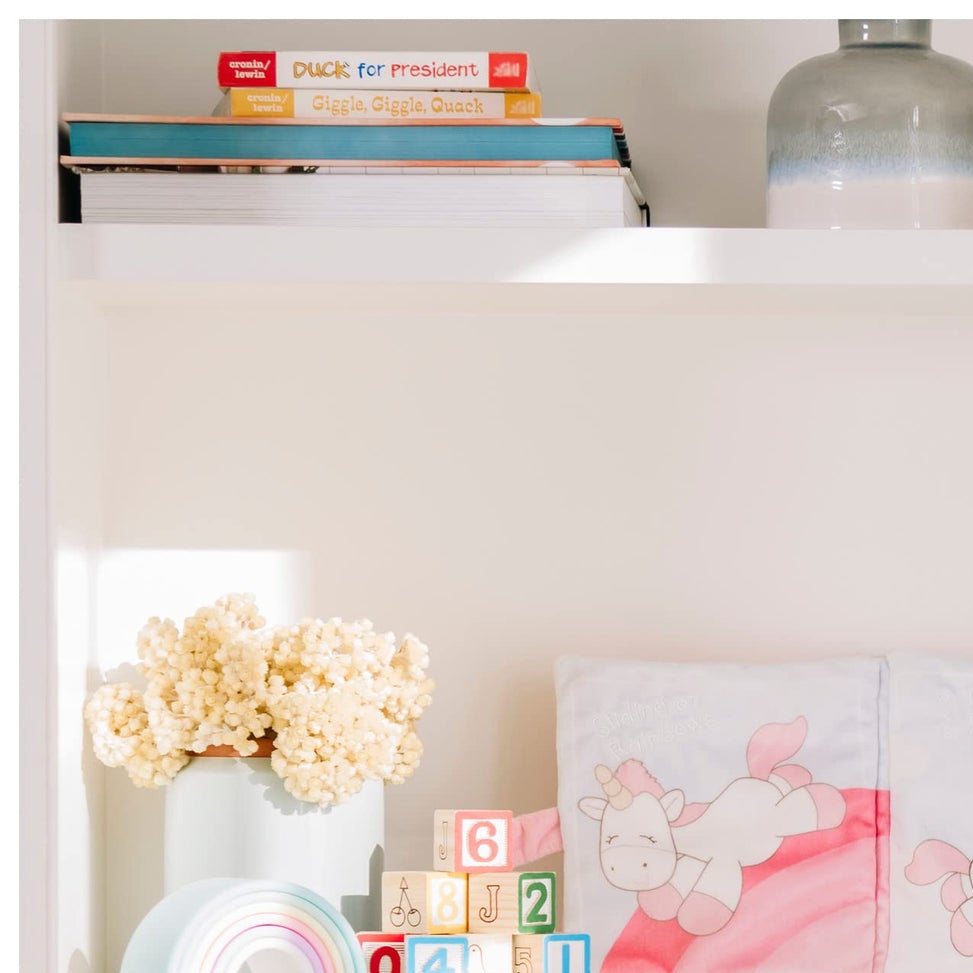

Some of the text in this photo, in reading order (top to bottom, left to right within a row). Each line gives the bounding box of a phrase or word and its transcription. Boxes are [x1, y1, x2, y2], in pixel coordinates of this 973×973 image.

[234, 70, 266, 79] lewin
[358, 62, 386, 78] for
[253, 104, 283, 112] lewin
[312, 95, 484, 117] Giggle, Giggle, Quack
[468, 821, 499, 862] 6
[437, 881, 459, 925] 8
[479, 885, 500, 923] J
[526, 882, 548, 923] 2
